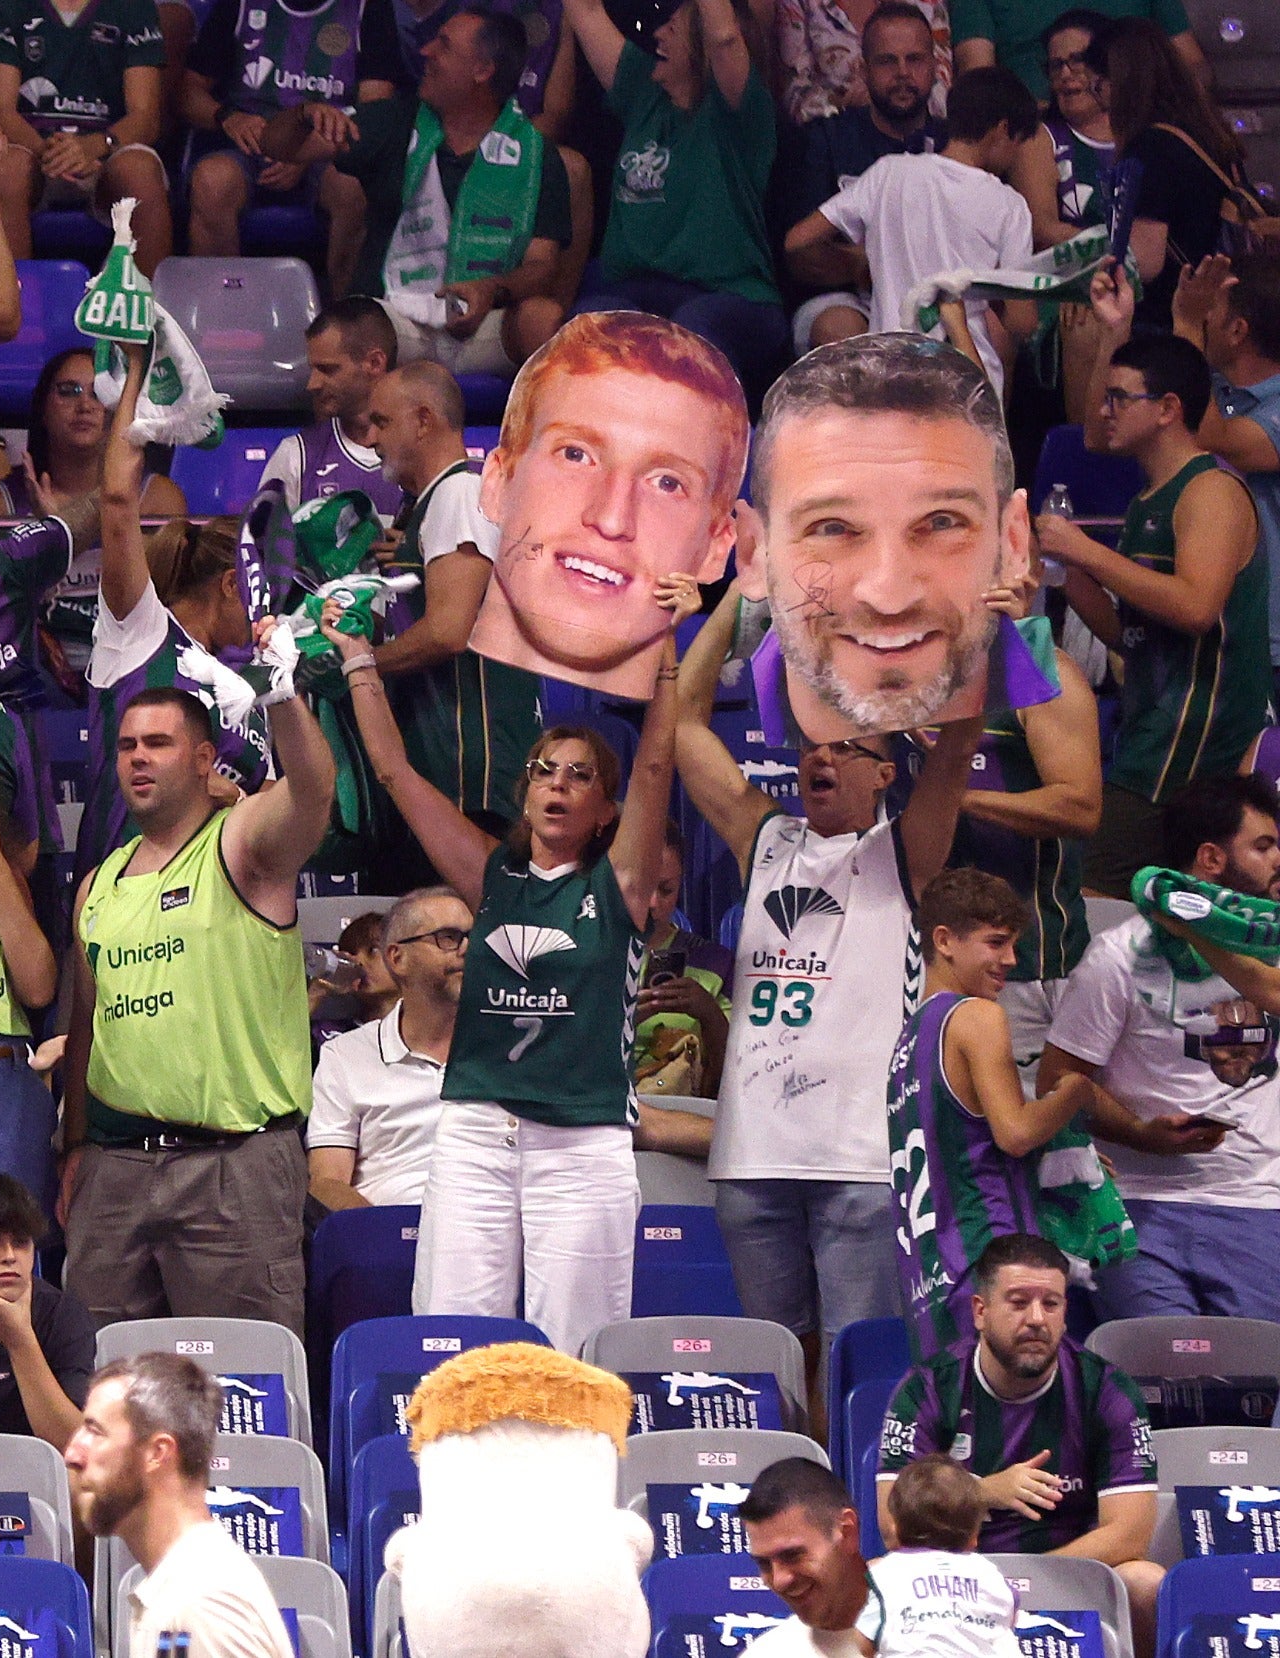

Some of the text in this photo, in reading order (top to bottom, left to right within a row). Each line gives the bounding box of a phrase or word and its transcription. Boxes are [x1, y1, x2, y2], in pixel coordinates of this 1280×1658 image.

[274, 68, 345, 98] Unicaja
[54, 95, 110, 116] Unicaja
[107, 935, 184, 969] Unicaja
[753, 948, 826, 975] Unicaja
[487, 987, 569, 1012] Unicaja
[749, 980, 815, 1027] 93
[508, 1017, 543, 1062] 7
[664, 1512, 677, 1558] ediolanum
